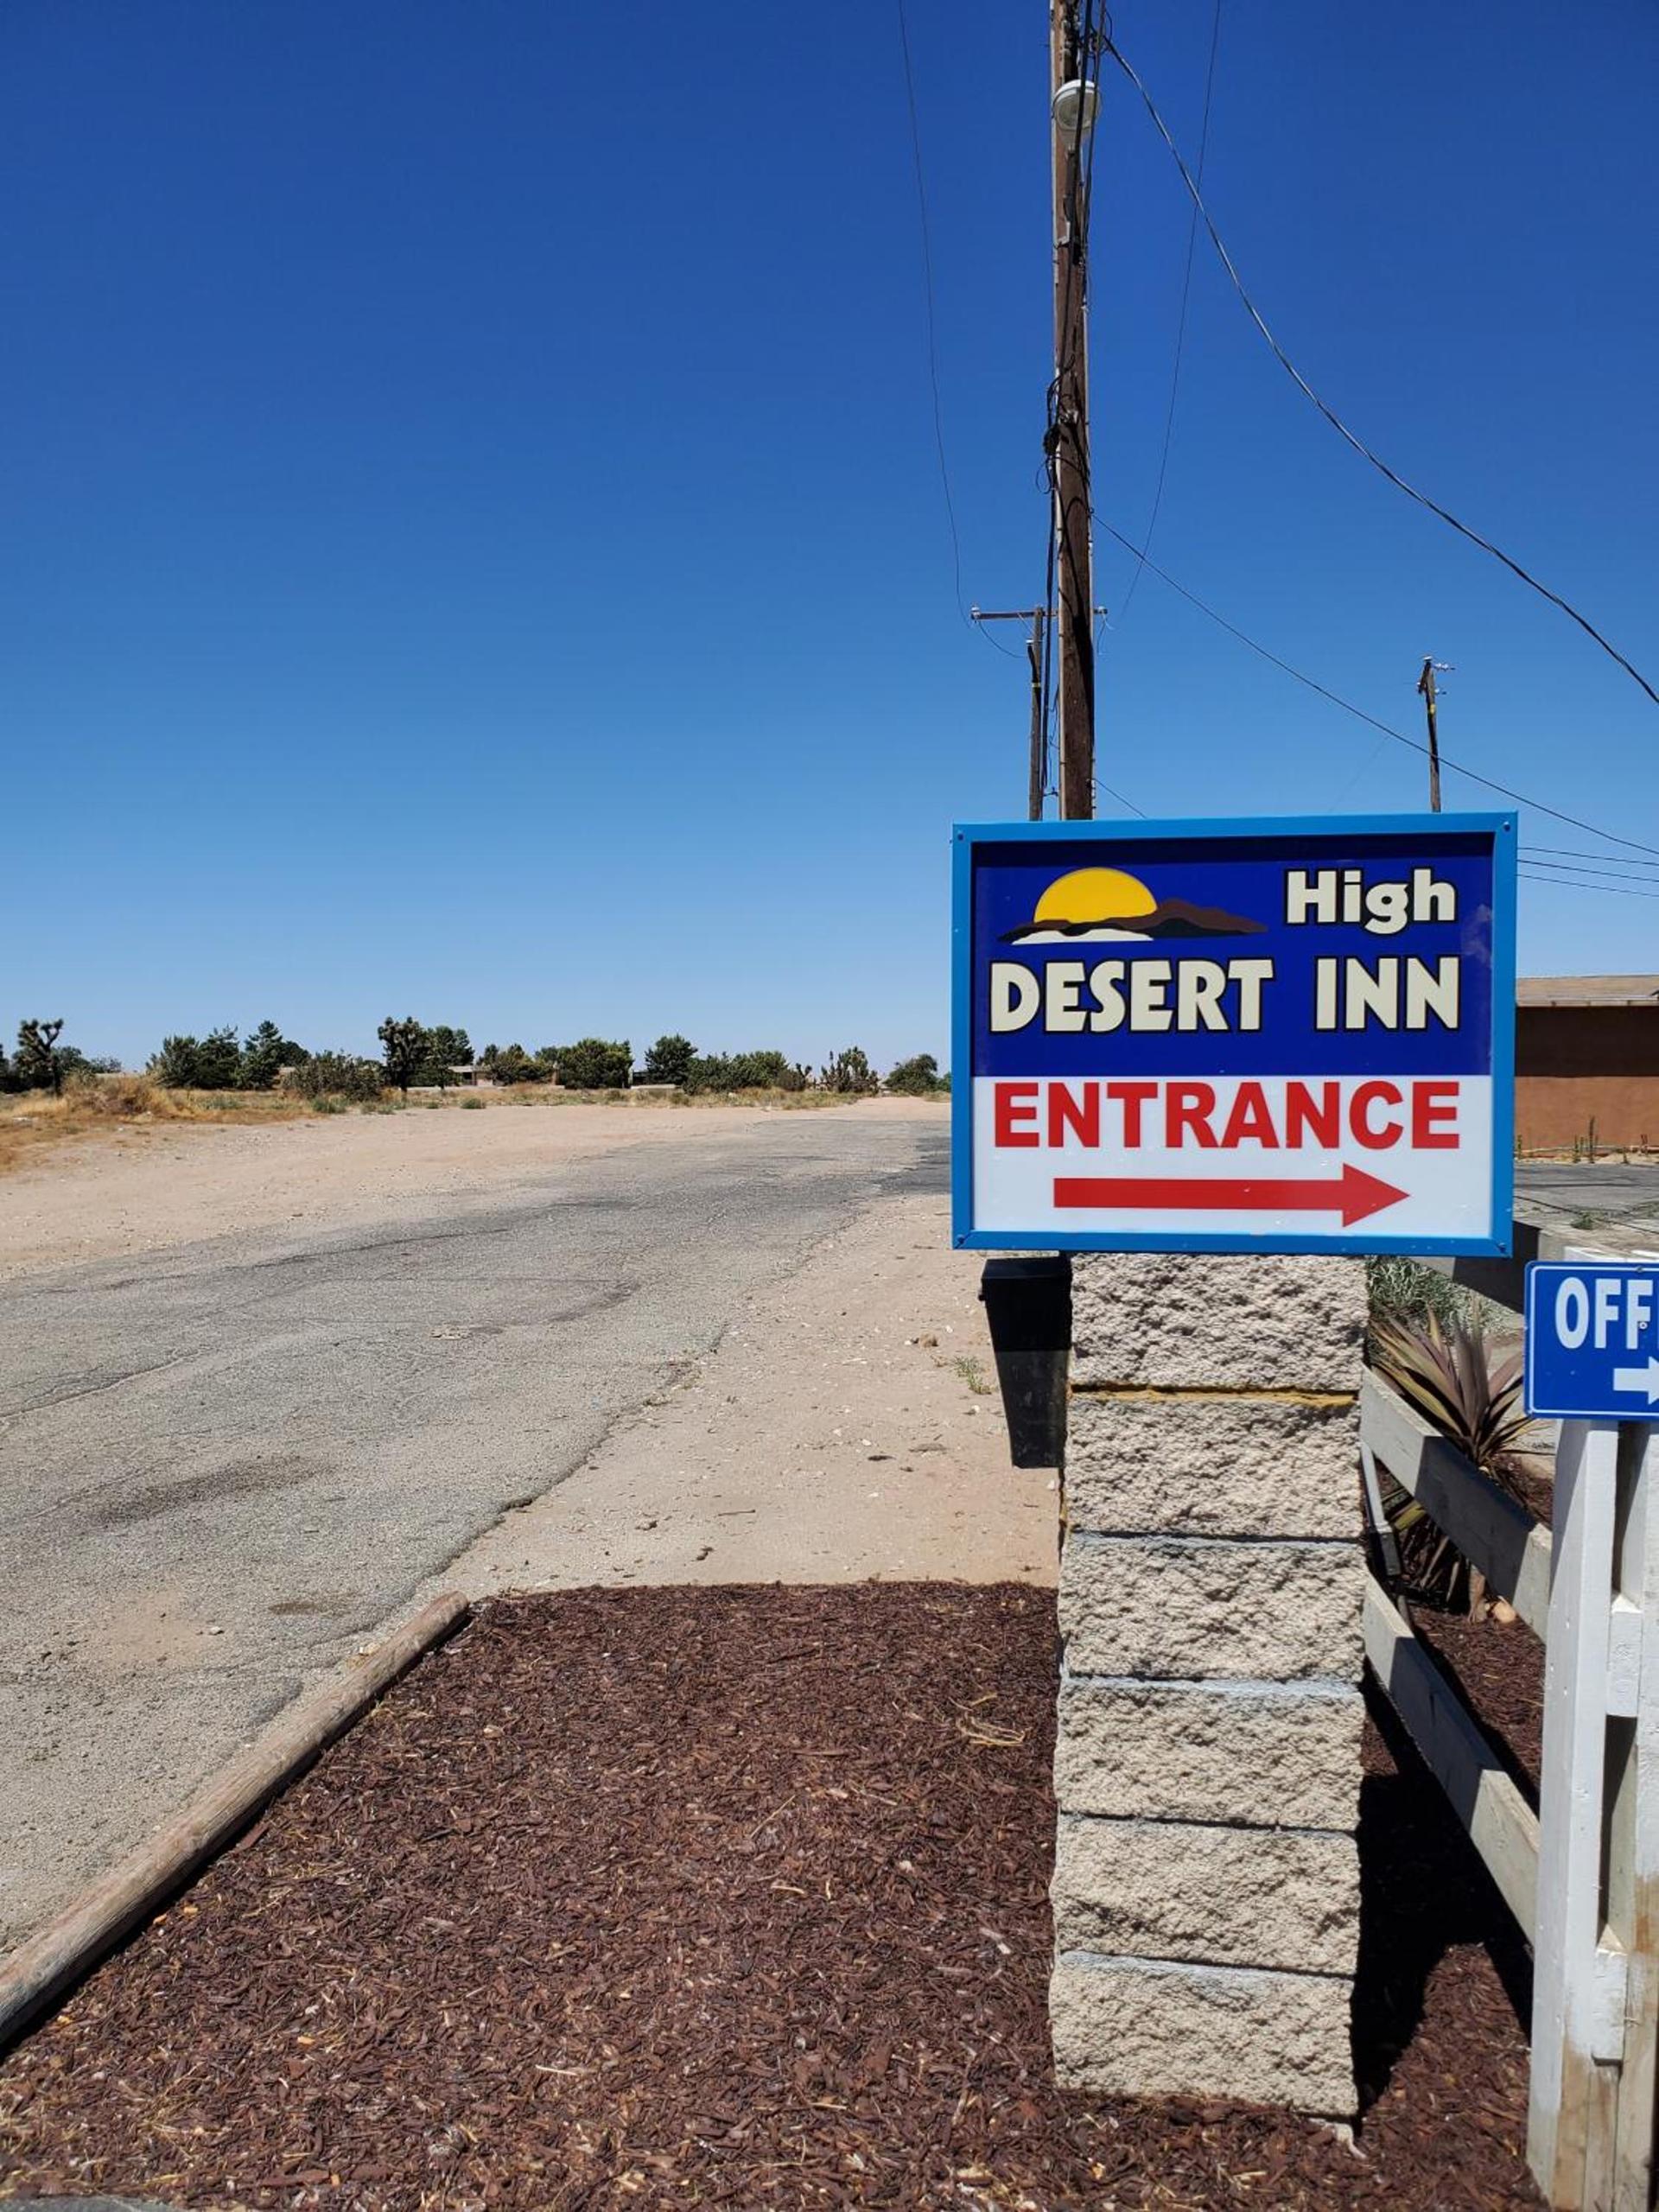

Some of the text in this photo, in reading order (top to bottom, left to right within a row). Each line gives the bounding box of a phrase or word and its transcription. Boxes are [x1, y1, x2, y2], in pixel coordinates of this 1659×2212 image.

[1284, 867, 1458, 936] High
[988, 957, 1461, 1033] DESERT INN
[994, 1080, 1460, 1150] ENTRANCE
[1554, 1276, 1659, 1351] OFF
